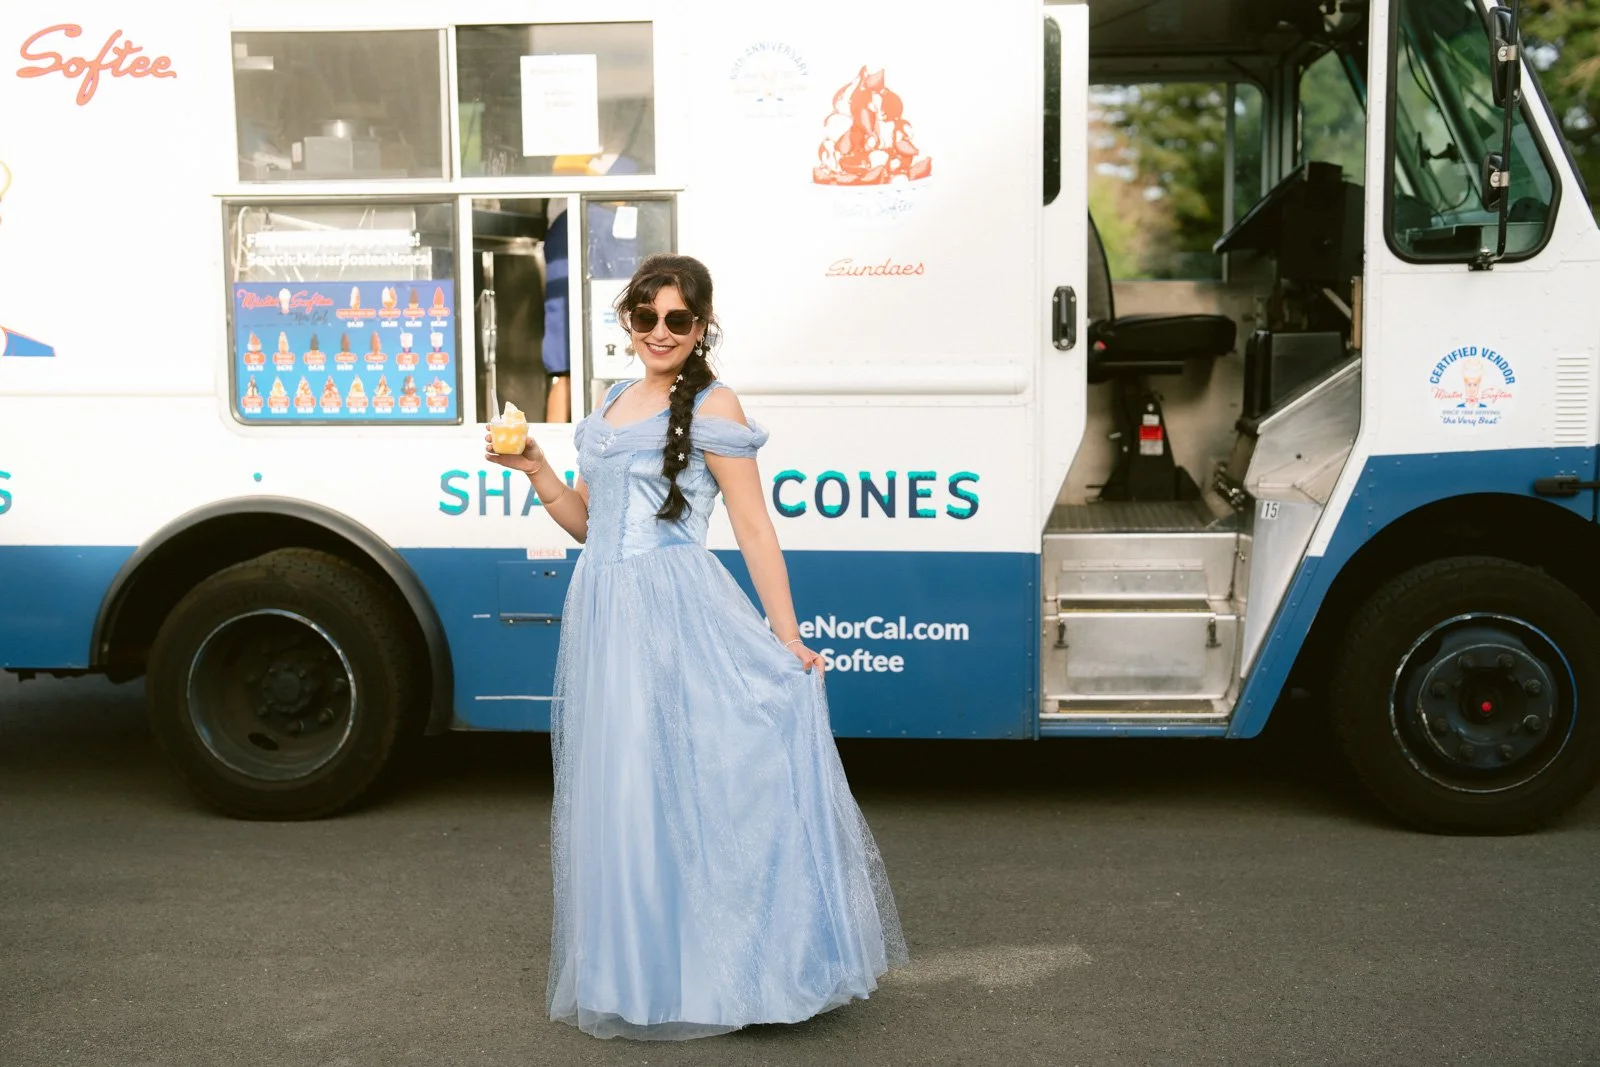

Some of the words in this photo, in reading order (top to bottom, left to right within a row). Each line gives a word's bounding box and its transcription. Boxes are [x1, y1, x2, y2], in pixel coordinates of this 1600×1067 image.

[16, 23, 177, 106] Softee
[745, 41, 809, 76] ANNIVERSARY
[825, 257, 925, 277] Sundaes
[237, 288, 280, 310] Mister
[290, 290, 334, 314] Softee
[1429, 346, 1478, 385] CERTIFIED
[1481, 347, 1516, 385] VENDOR
[1431, 386, 1463, 400] Mister
[1480, 387, 1513, 403] Softee
[1457, 416, 1477, 427] Very
[772, 469, 980, 520] CONES
[1264, 502, 1279, 519] 15
[528, 549, 565, 558] DIESEL
[798, 615, 969, 641] eNorCal.com
